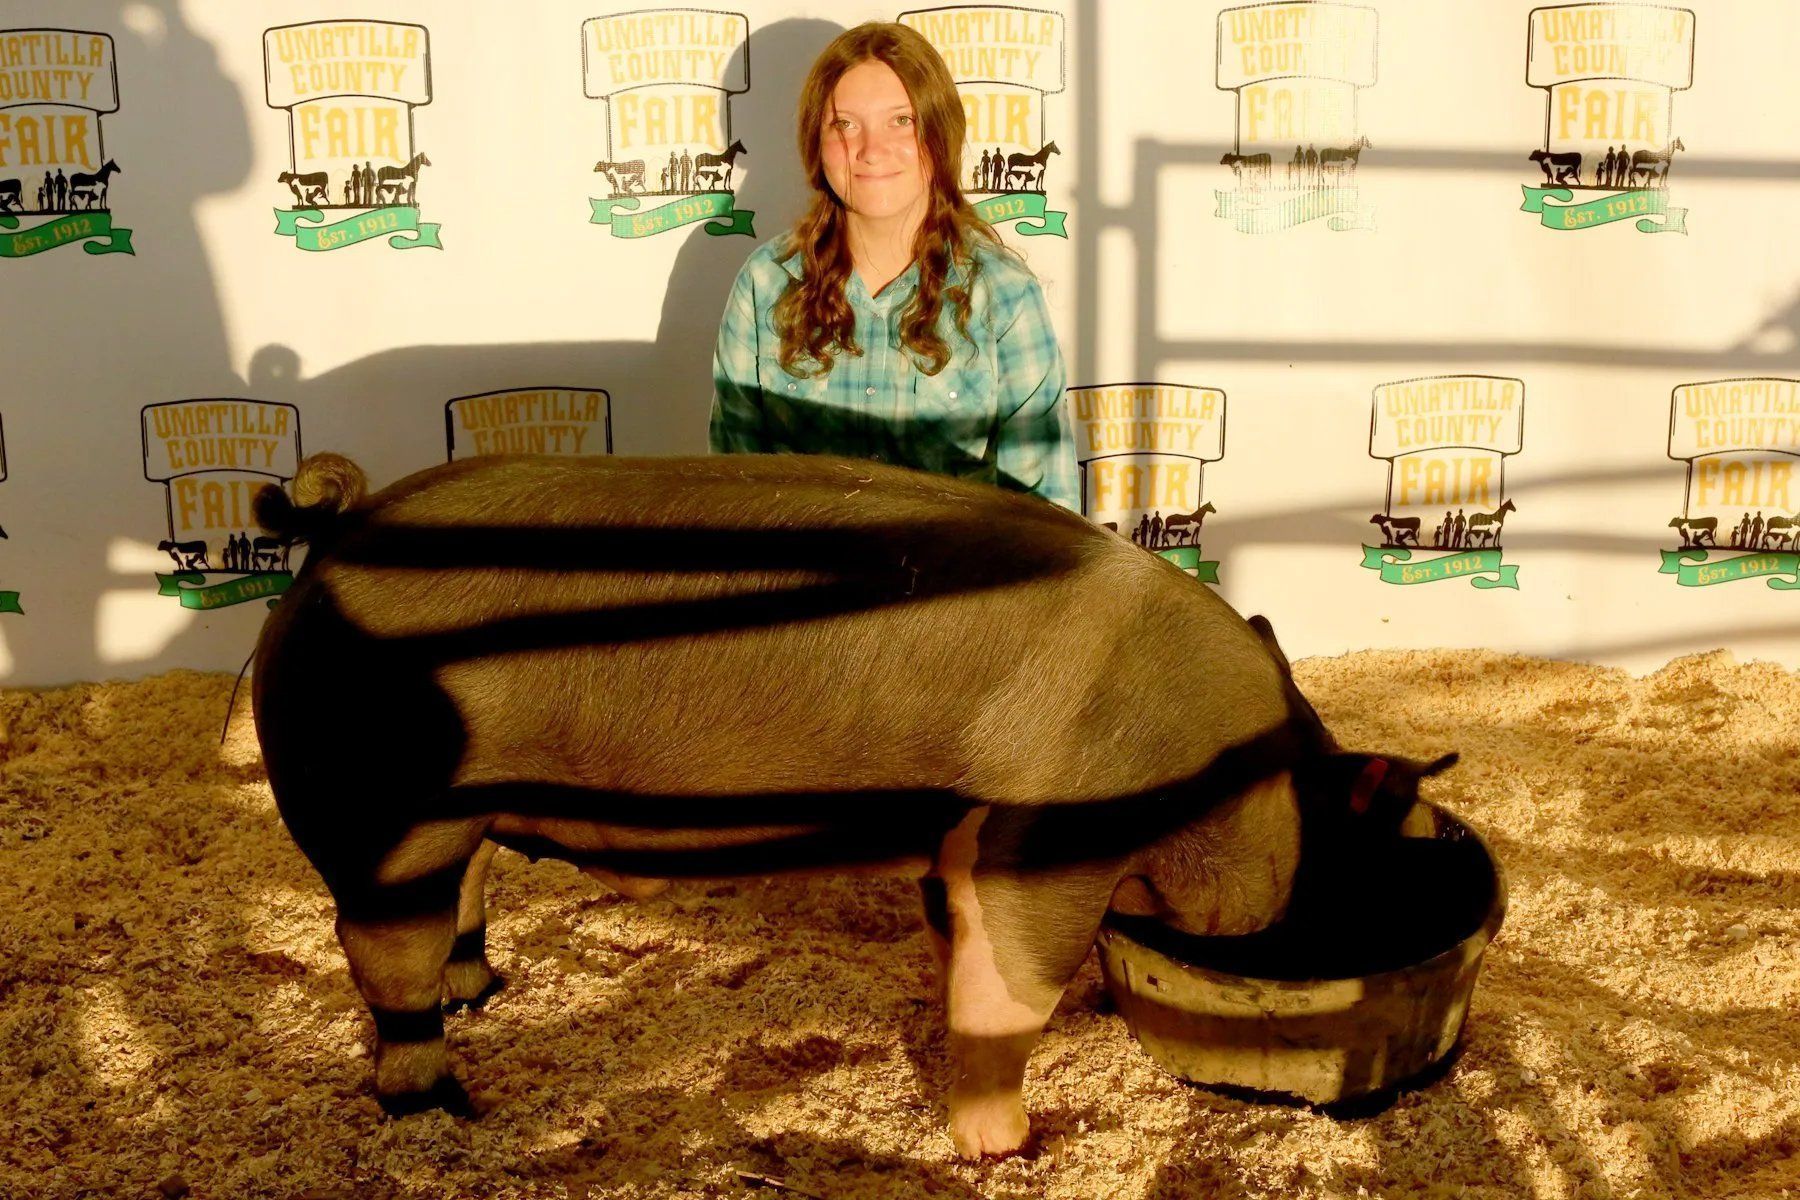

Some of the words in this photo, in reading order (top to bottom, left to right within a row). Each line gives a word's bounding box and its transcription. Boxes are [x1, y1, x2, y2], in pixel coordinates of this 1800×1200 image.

[0, 34, 104, 68] ATILLA
[275, 25, 419, 64] UMATILLA
[593, 14, 740, 53] UMATILLA
[290, 61, 408, 95] COUNTY
[608, 49, 725, 85] COUNTY
[943, 47, 1040, 81] OUNTY
[0, 70, 94, 102] OUNTY
[617, 93, 724, 151] FAIR
[961, 93, 1037, 151] AIR
[1557, 85, 1660, 148] FAIR
[298, 104, 409, 165] FAIR
[358, 213, 398, 236] 1912
[674, 200, 715, 223] 1912
[985, 200, 1026, 221] 1912
[1606, 196, 1649, 219] 1912
[53, 219, 92, 241] 1912
[457, 391, 601, 431] UMATILLA
[1074, 386, 1218, 422] UMATILLA
[1385, 380, 1516, 417] UMATILLA
[1684, 383, 1800, 419] UMATILL
[152, 403, 289, 439] UMATILLA
[1086, 421, 1205, 453] COUNTY
[1395, 414, 1502, 448] COUNTY
[166, 437, 279, 470] COUNTY
[472, 425, 589, 454] COUNTY
[1091, 461, 1194, 512] FAIR
[1398, 456, 1494, 510] FAIR
[1697, 456, 1794, 513] FAIR
[1443, 556, 1483, 575] 1912
[1740, 557, 1780, 576] 1912
